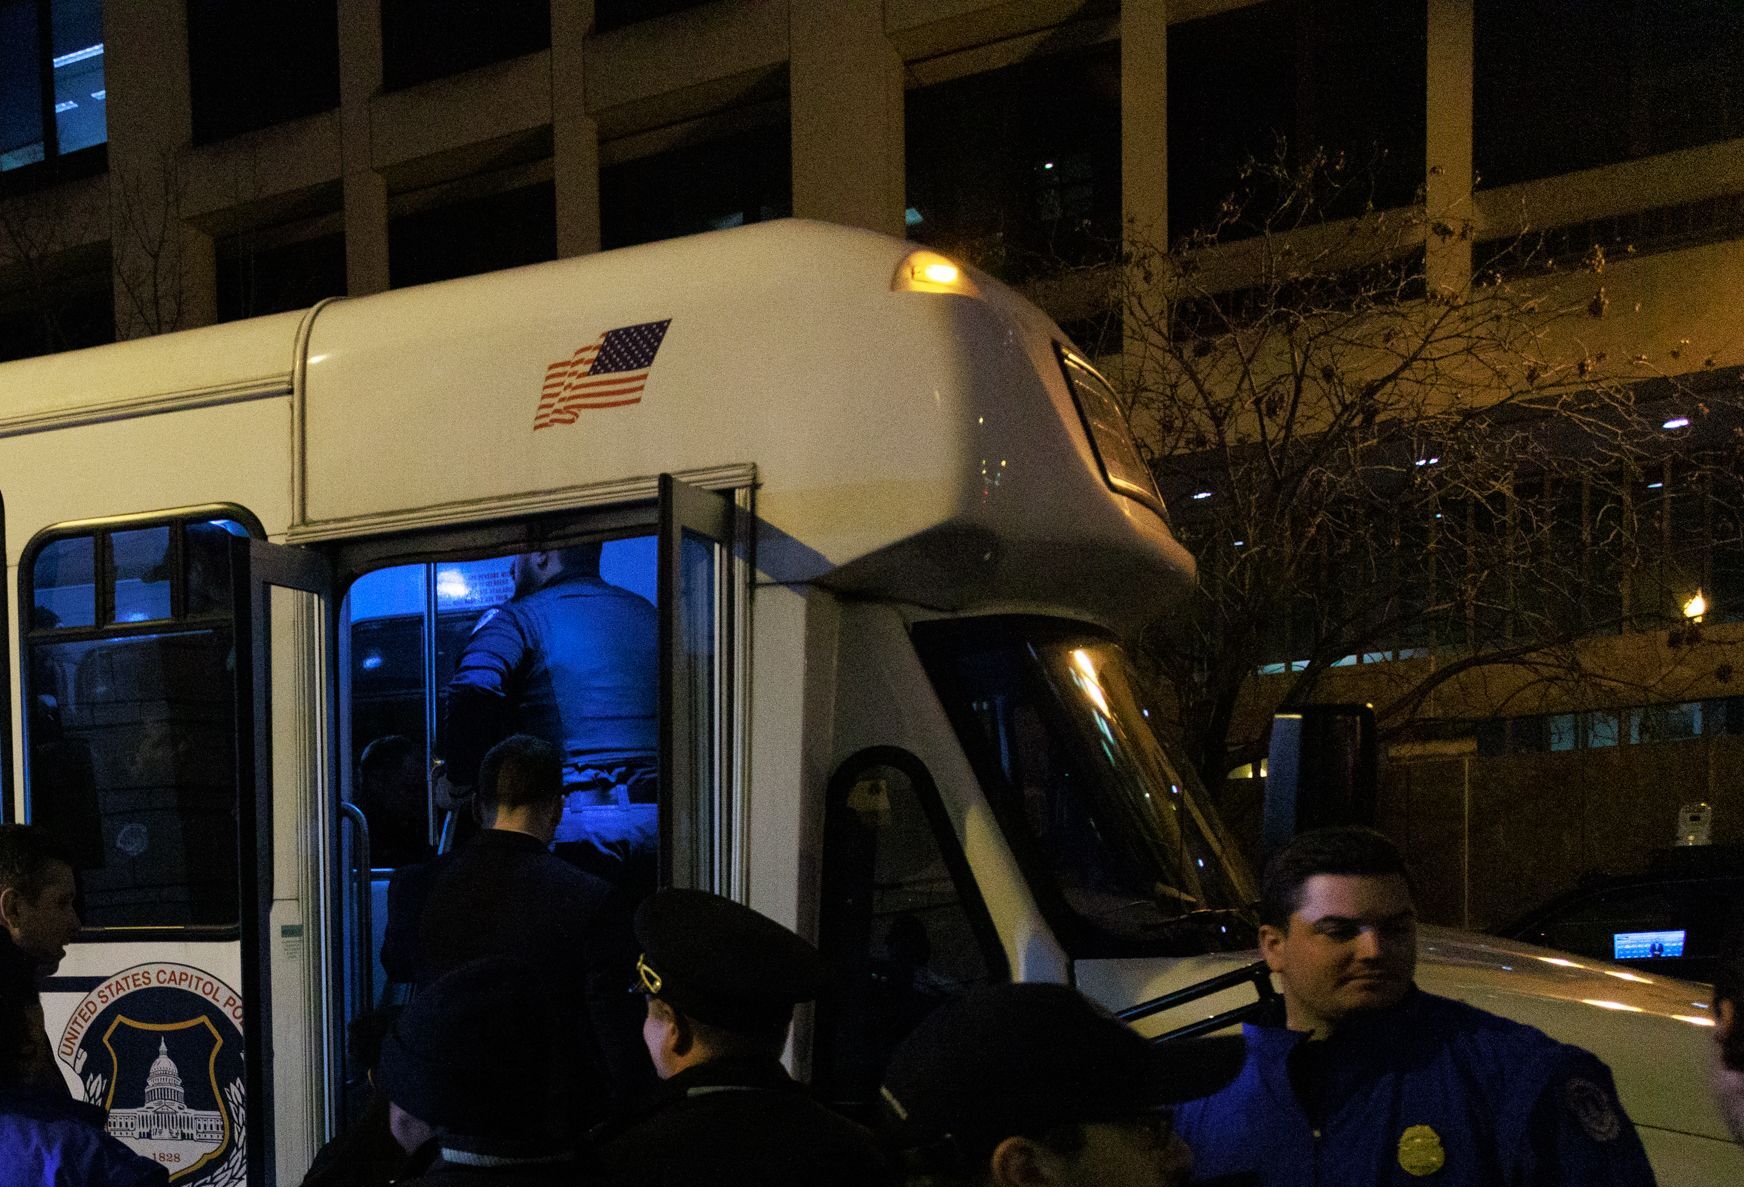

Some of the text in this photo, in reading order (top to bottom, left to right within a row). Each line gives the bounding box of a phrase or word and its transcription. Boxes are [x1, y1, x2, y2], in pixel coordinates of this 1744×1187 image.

[61, 969, 220, 1057] UNITED STATES CAPITOL
[152, 1152, 181, 1163] 1828
